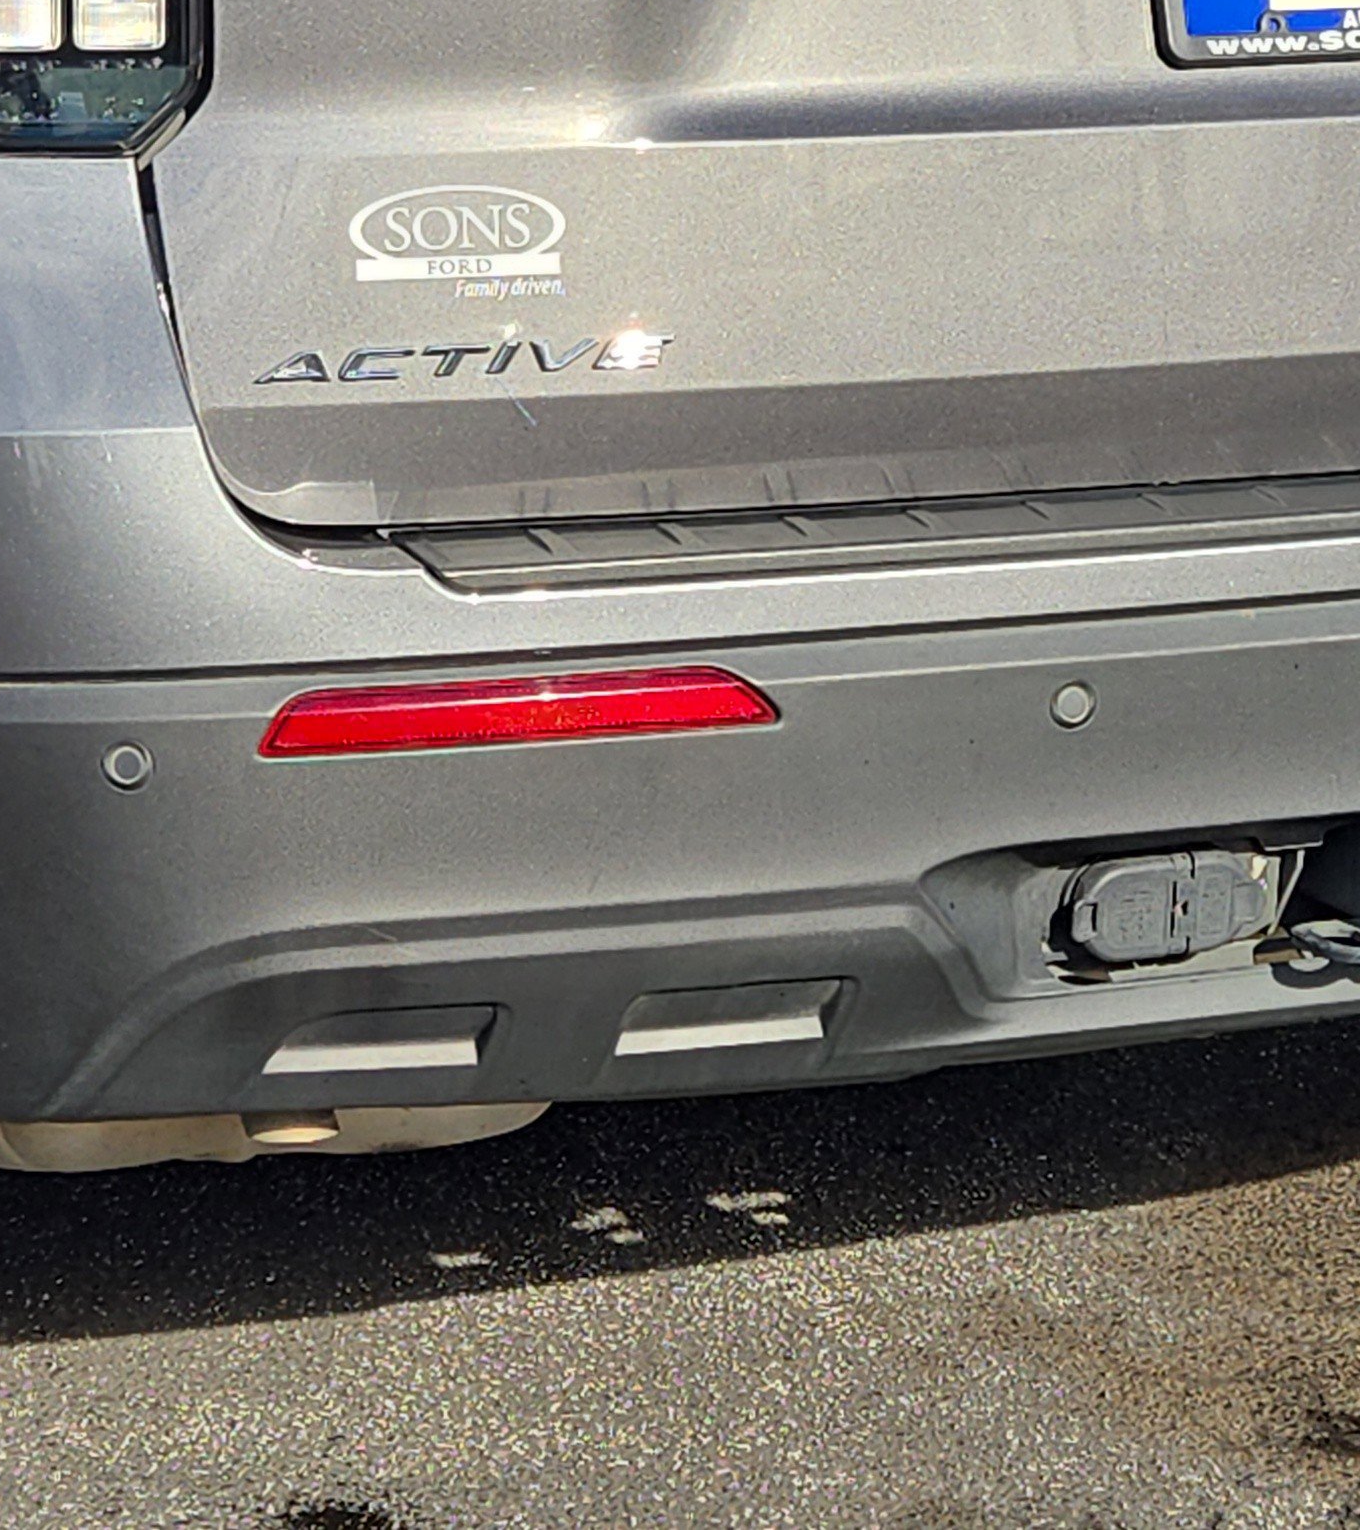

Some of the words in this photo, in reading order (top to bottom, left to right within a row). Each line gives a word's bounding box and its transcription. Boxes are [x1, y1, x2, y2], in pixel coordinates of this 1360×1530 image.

[384, 202, 532, 253] SONS
[427, 258, 492, 275] FORD
[253, 332, 676, 385] ACTIVE
